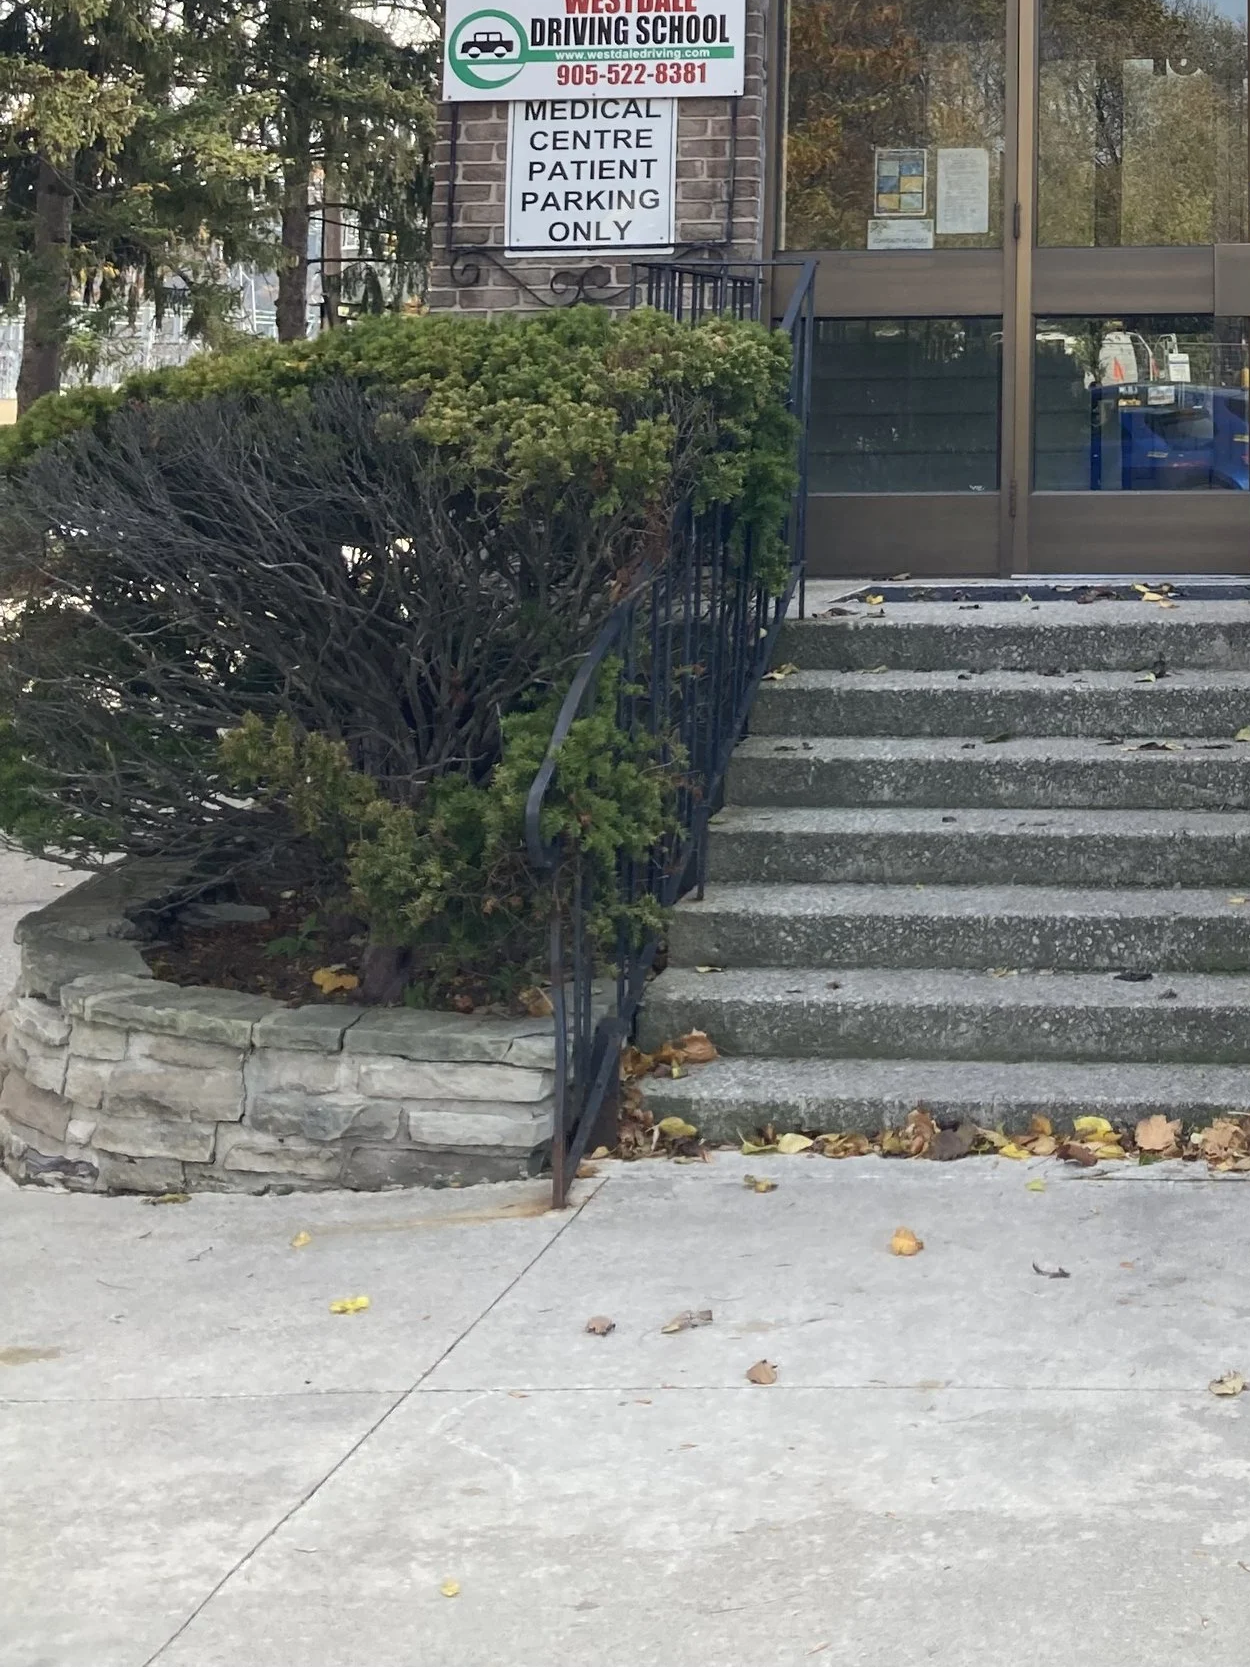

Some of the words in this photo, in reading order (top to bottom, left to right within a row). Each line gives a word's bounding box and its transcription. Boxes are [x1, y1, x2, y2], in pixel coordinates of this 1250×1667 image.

[530, 17, 629, 47] DRIVING
[636, 14, 730, 44] SCHOOL
[555, 49, 710, 61] www.westdaledriving.com
[557, 62, 706, 86] 905-522-8381
[524, 99, 661, 121] MEDICAL
[530, 129, 653, 151] CENTRE
[528, 159, 658, 181] PATIENT
[521, 189, 660, 212] PARKING
[548, 220, 632, 242] ONLY
